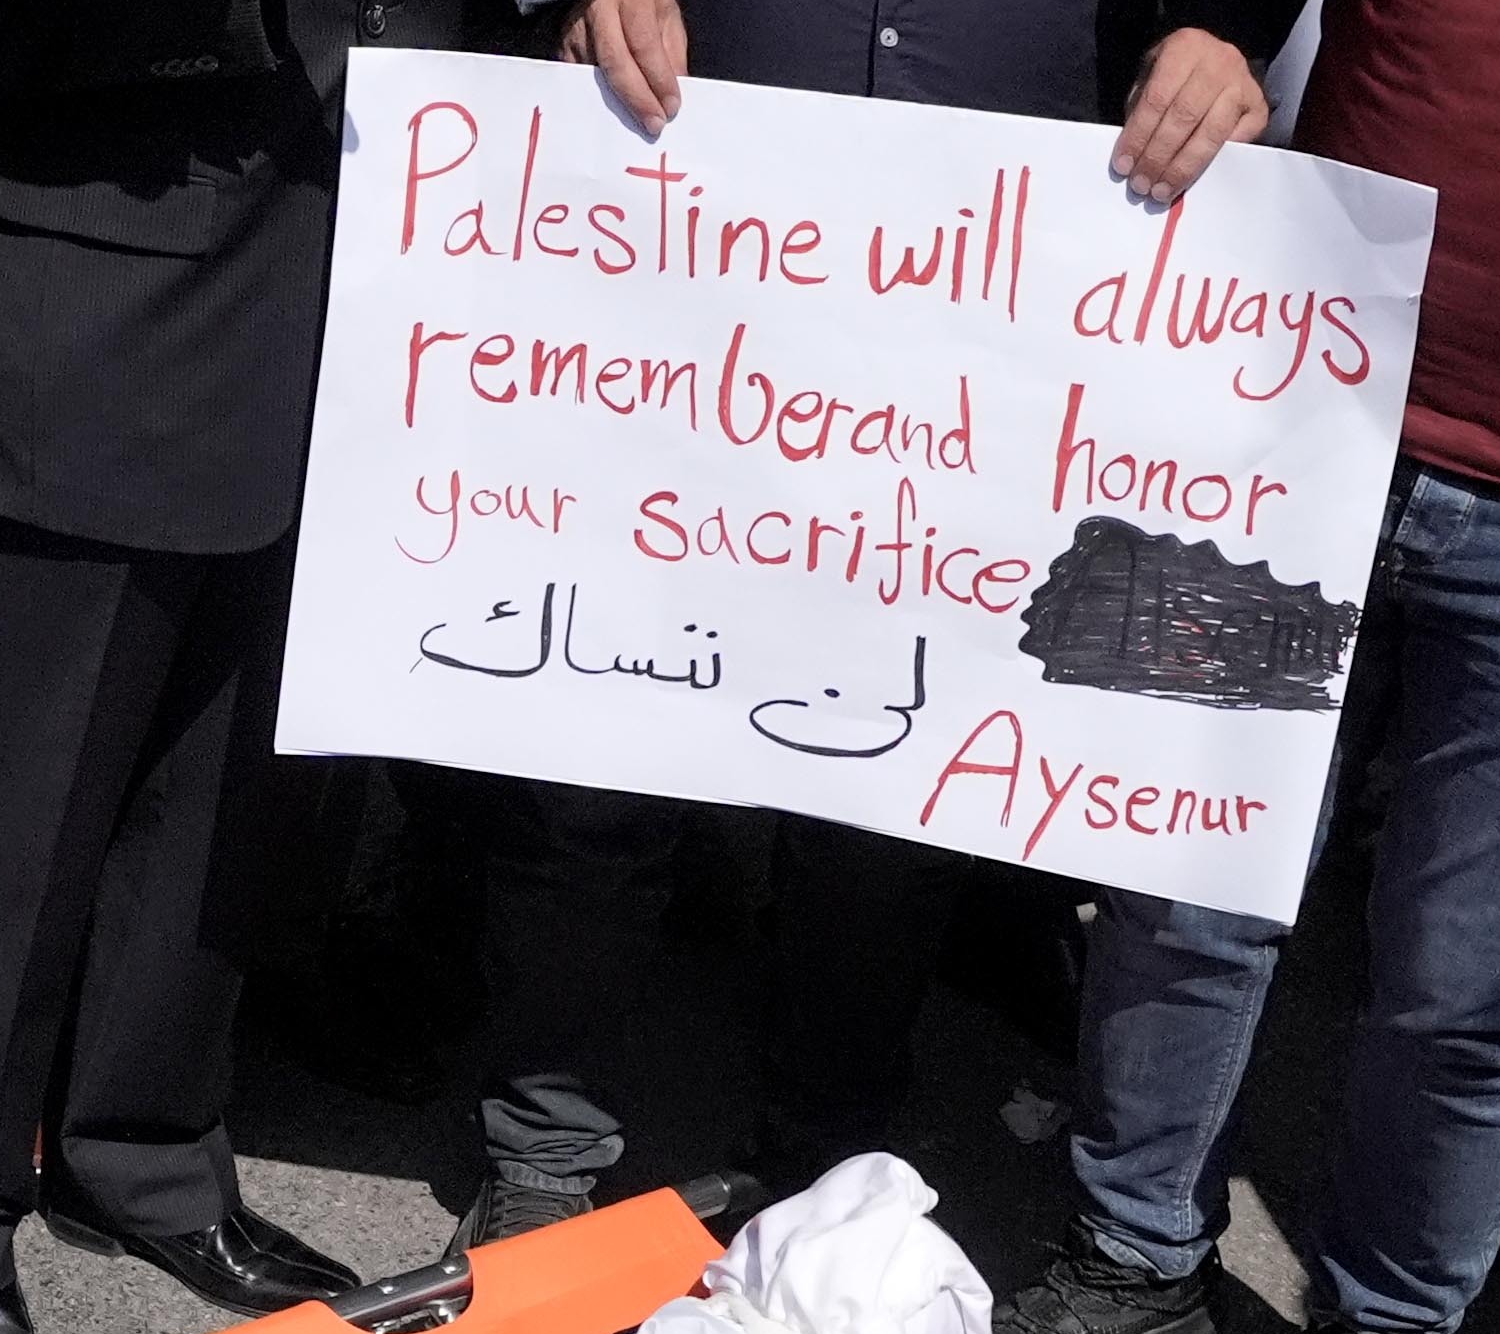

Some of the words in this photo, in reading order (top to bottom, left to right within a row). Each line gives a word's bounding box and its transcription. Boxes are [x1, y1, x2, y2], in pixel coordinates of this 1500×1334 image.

[400, 101, 829, 285] Palestine
[868, 165, 1031, 323] will
[1072, 190, 1371, 402] always
[394, 469, 577, 565] your
[1052, 383, 1288, 535] honor
[750, 634, 926, 758] لن
[919, 710, 1268, 862] Aysenur
